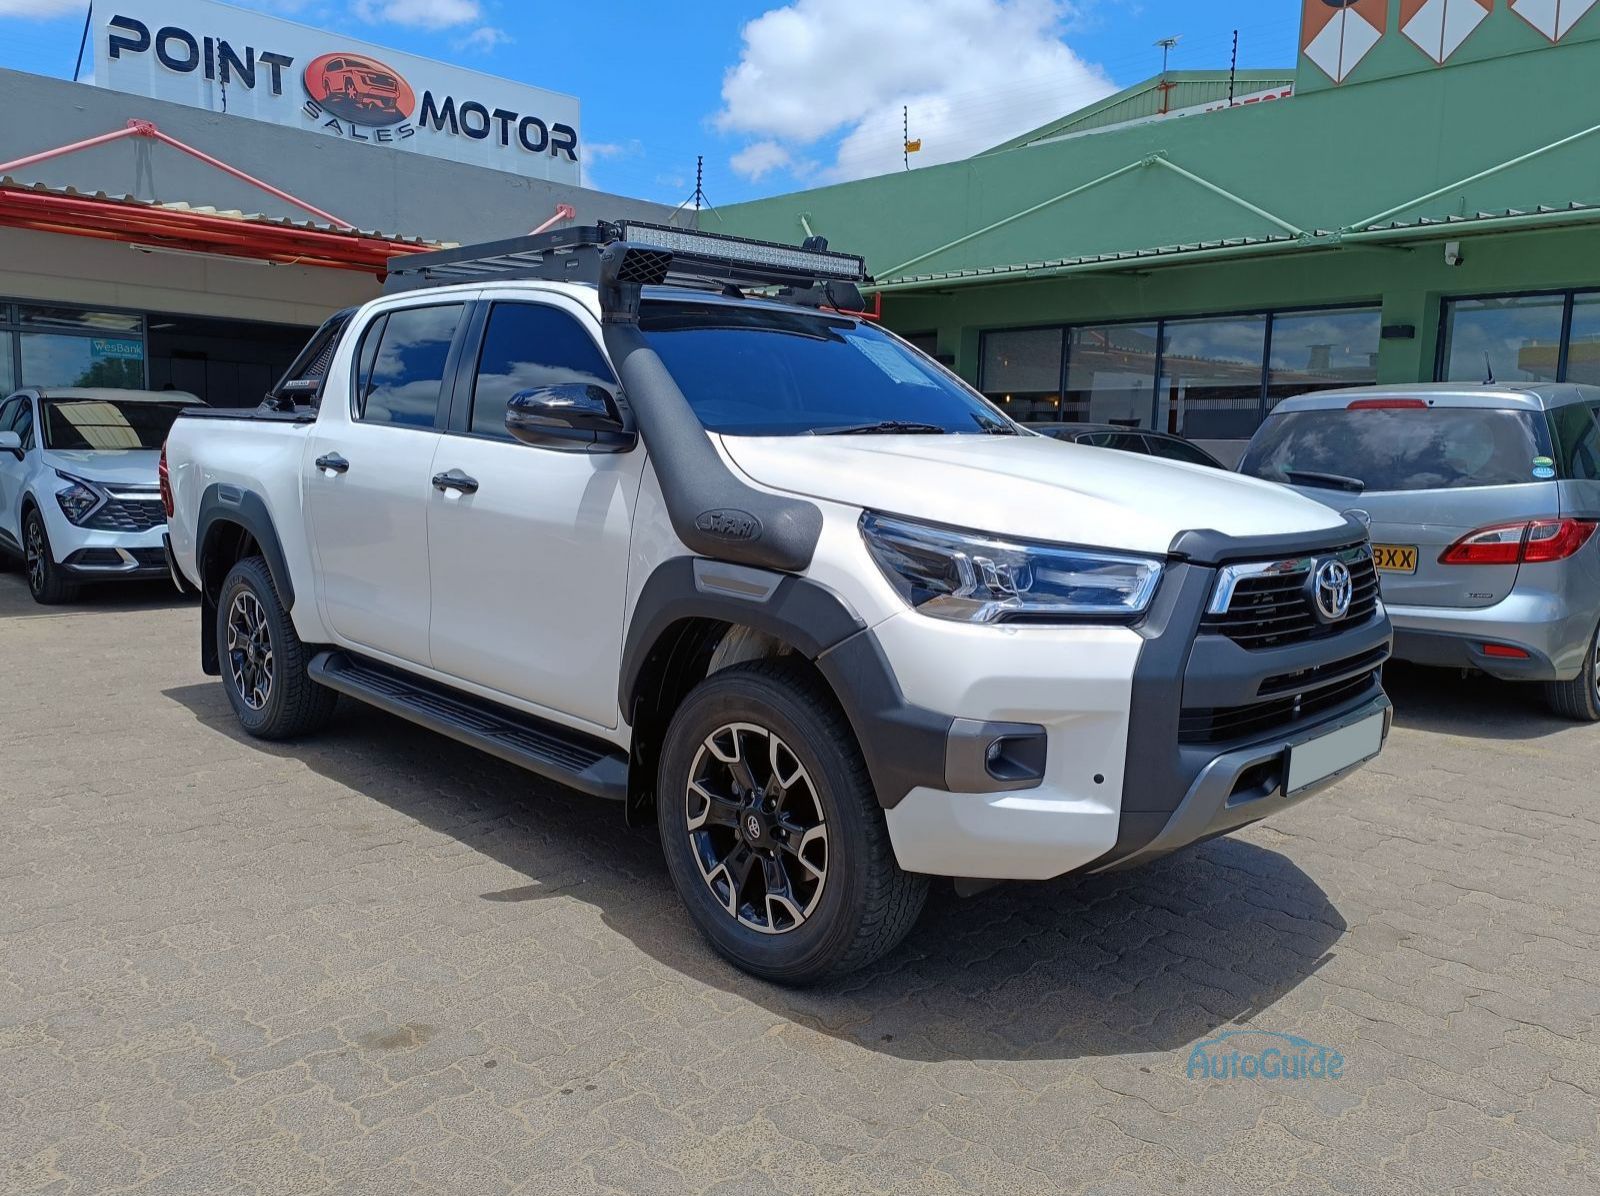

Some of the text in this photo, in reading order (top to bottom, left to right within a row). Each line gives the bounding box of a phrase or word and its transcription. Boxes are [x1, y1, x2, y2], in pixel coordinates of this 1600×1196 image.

[107, 14, 578, 163] POINT MOTOR
[302, 100, 415, 142] SALES
[93, 341, 142, 354] WesBank
[1373, 548, 1413, 568] BXX
